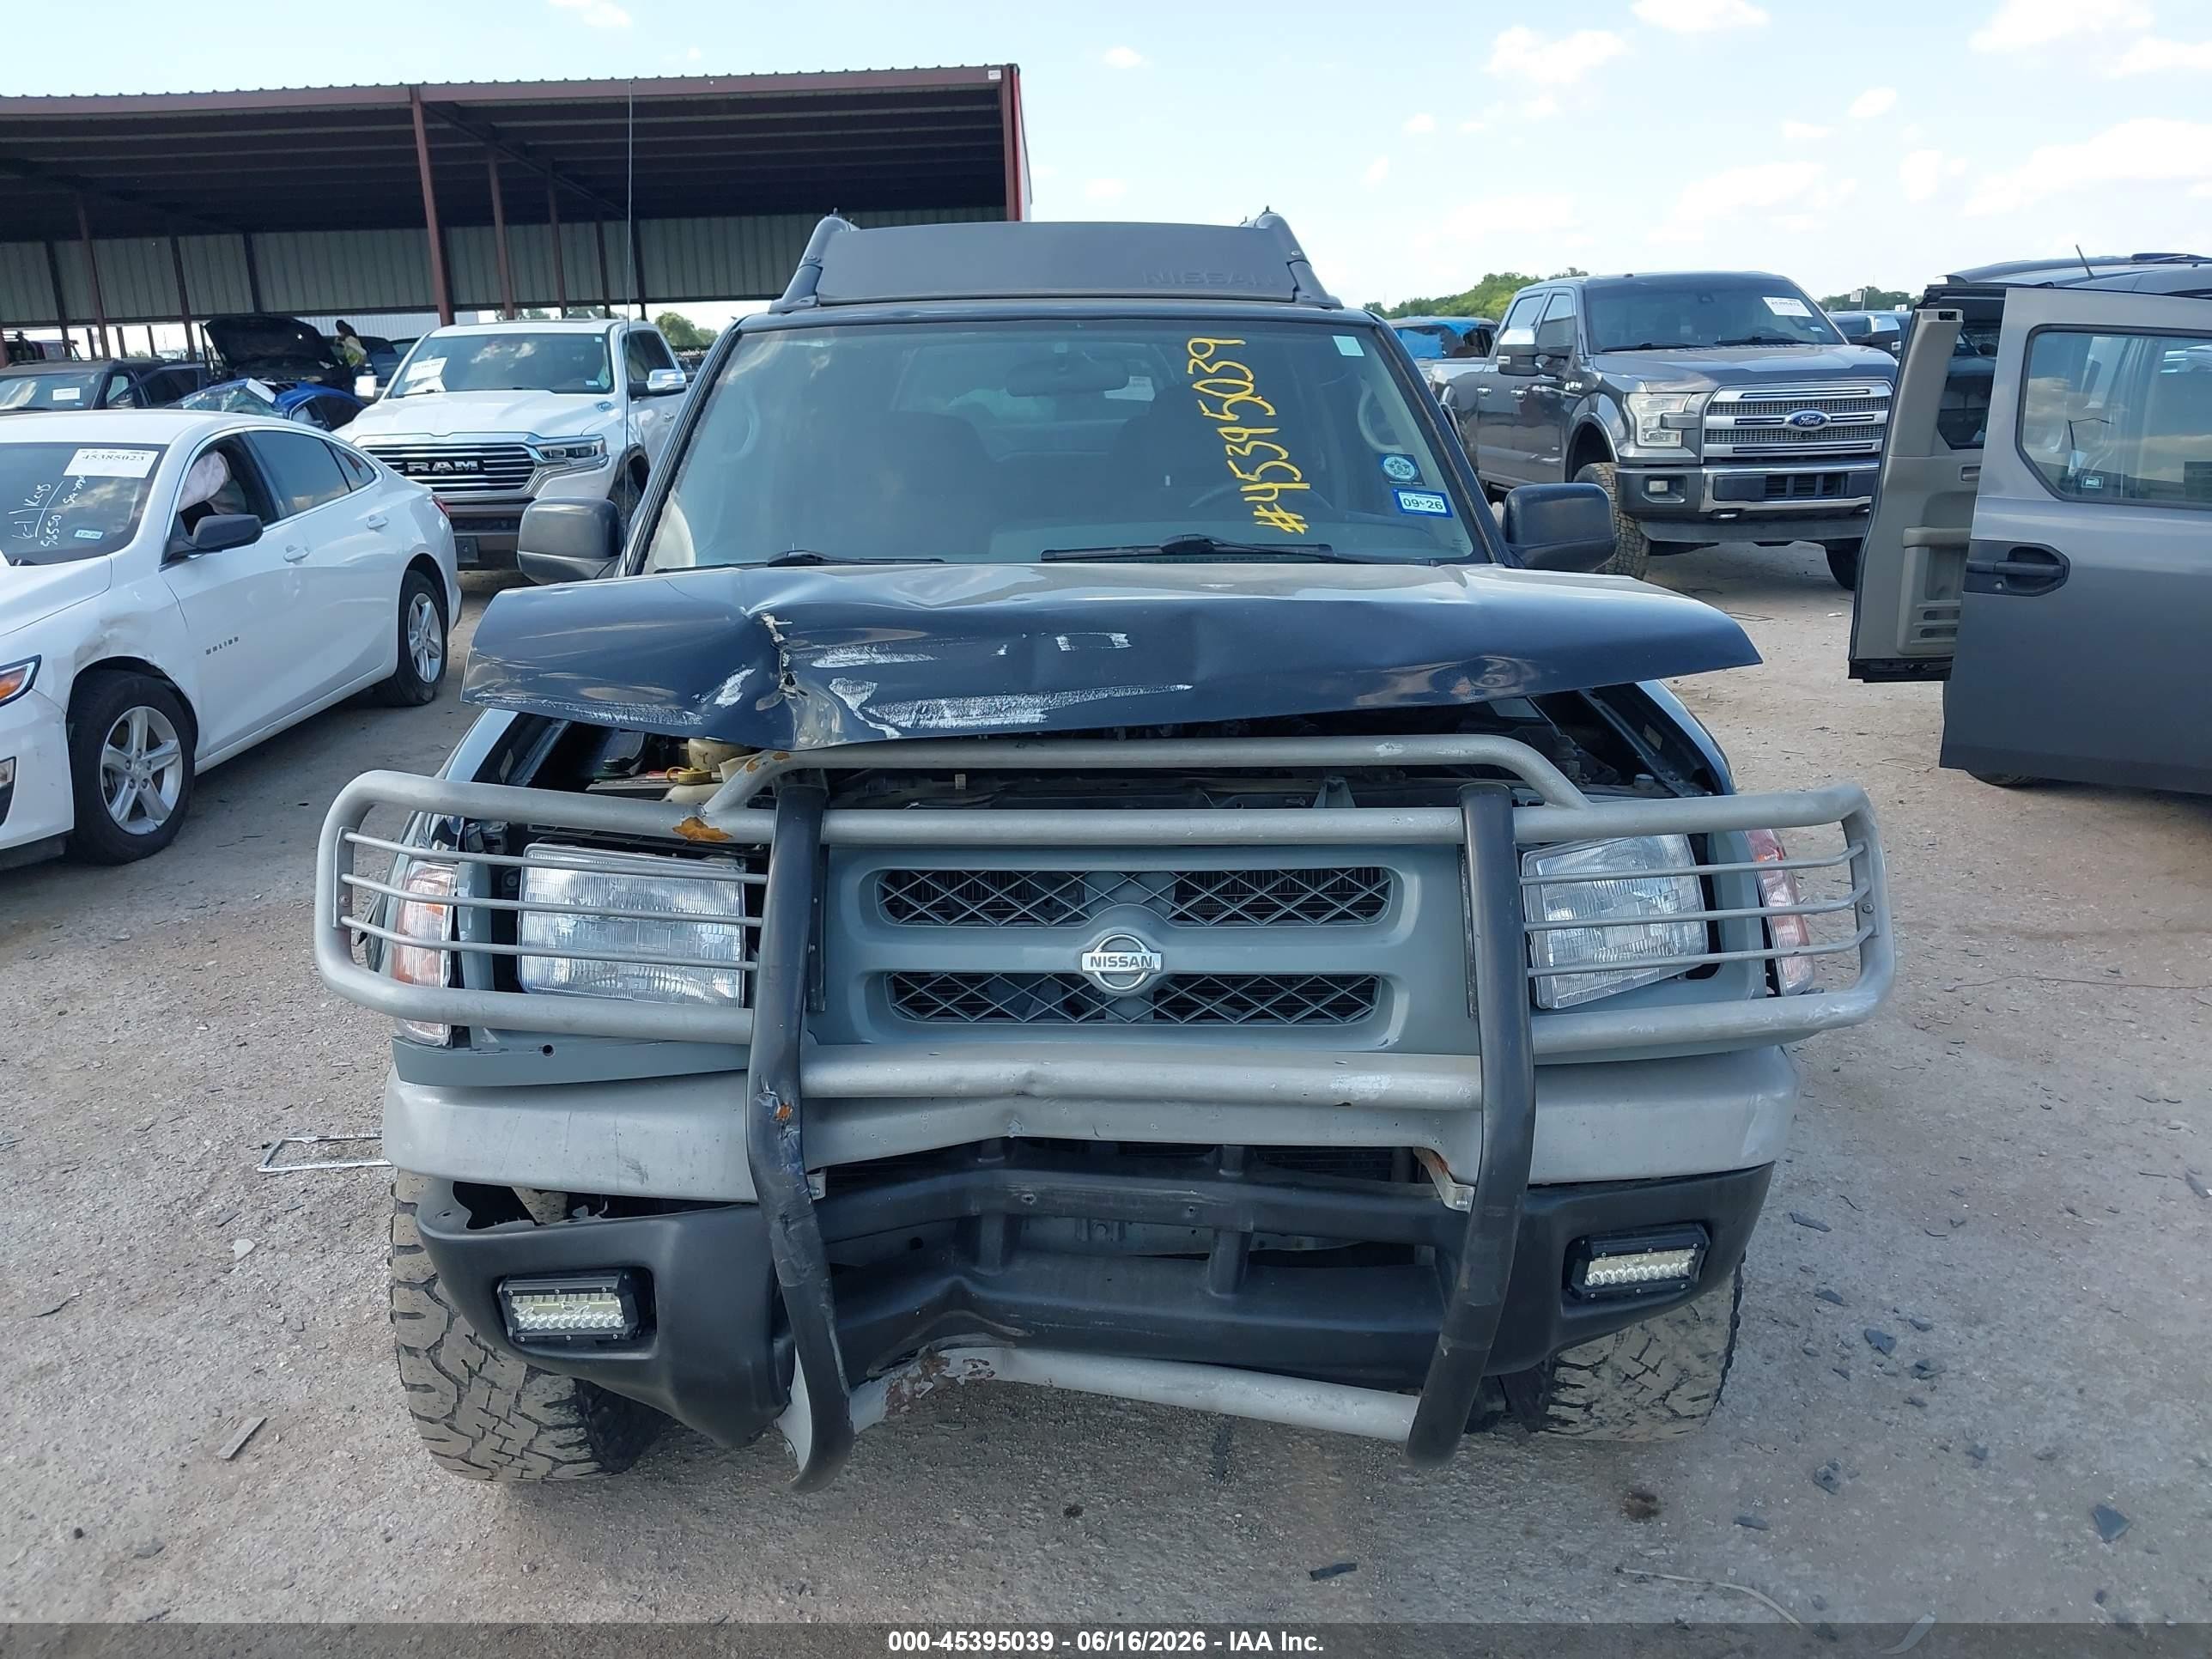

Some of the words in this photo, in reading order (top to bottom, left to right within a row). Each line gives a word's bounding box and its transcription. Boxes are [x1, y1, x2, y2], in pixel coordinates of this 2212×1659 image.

[1142, 268, 1278, 287] NISSAN
[1799, 415, 1821, 426] Ford
[1187, 337, 1311, 535] #45395039
[406, 460, 479, 471] RAM
[1402, 498, 1419, 507] 09
[1425, 500, 1443, 510] 26
[1090, 954, 1153, 969] NISSAN
